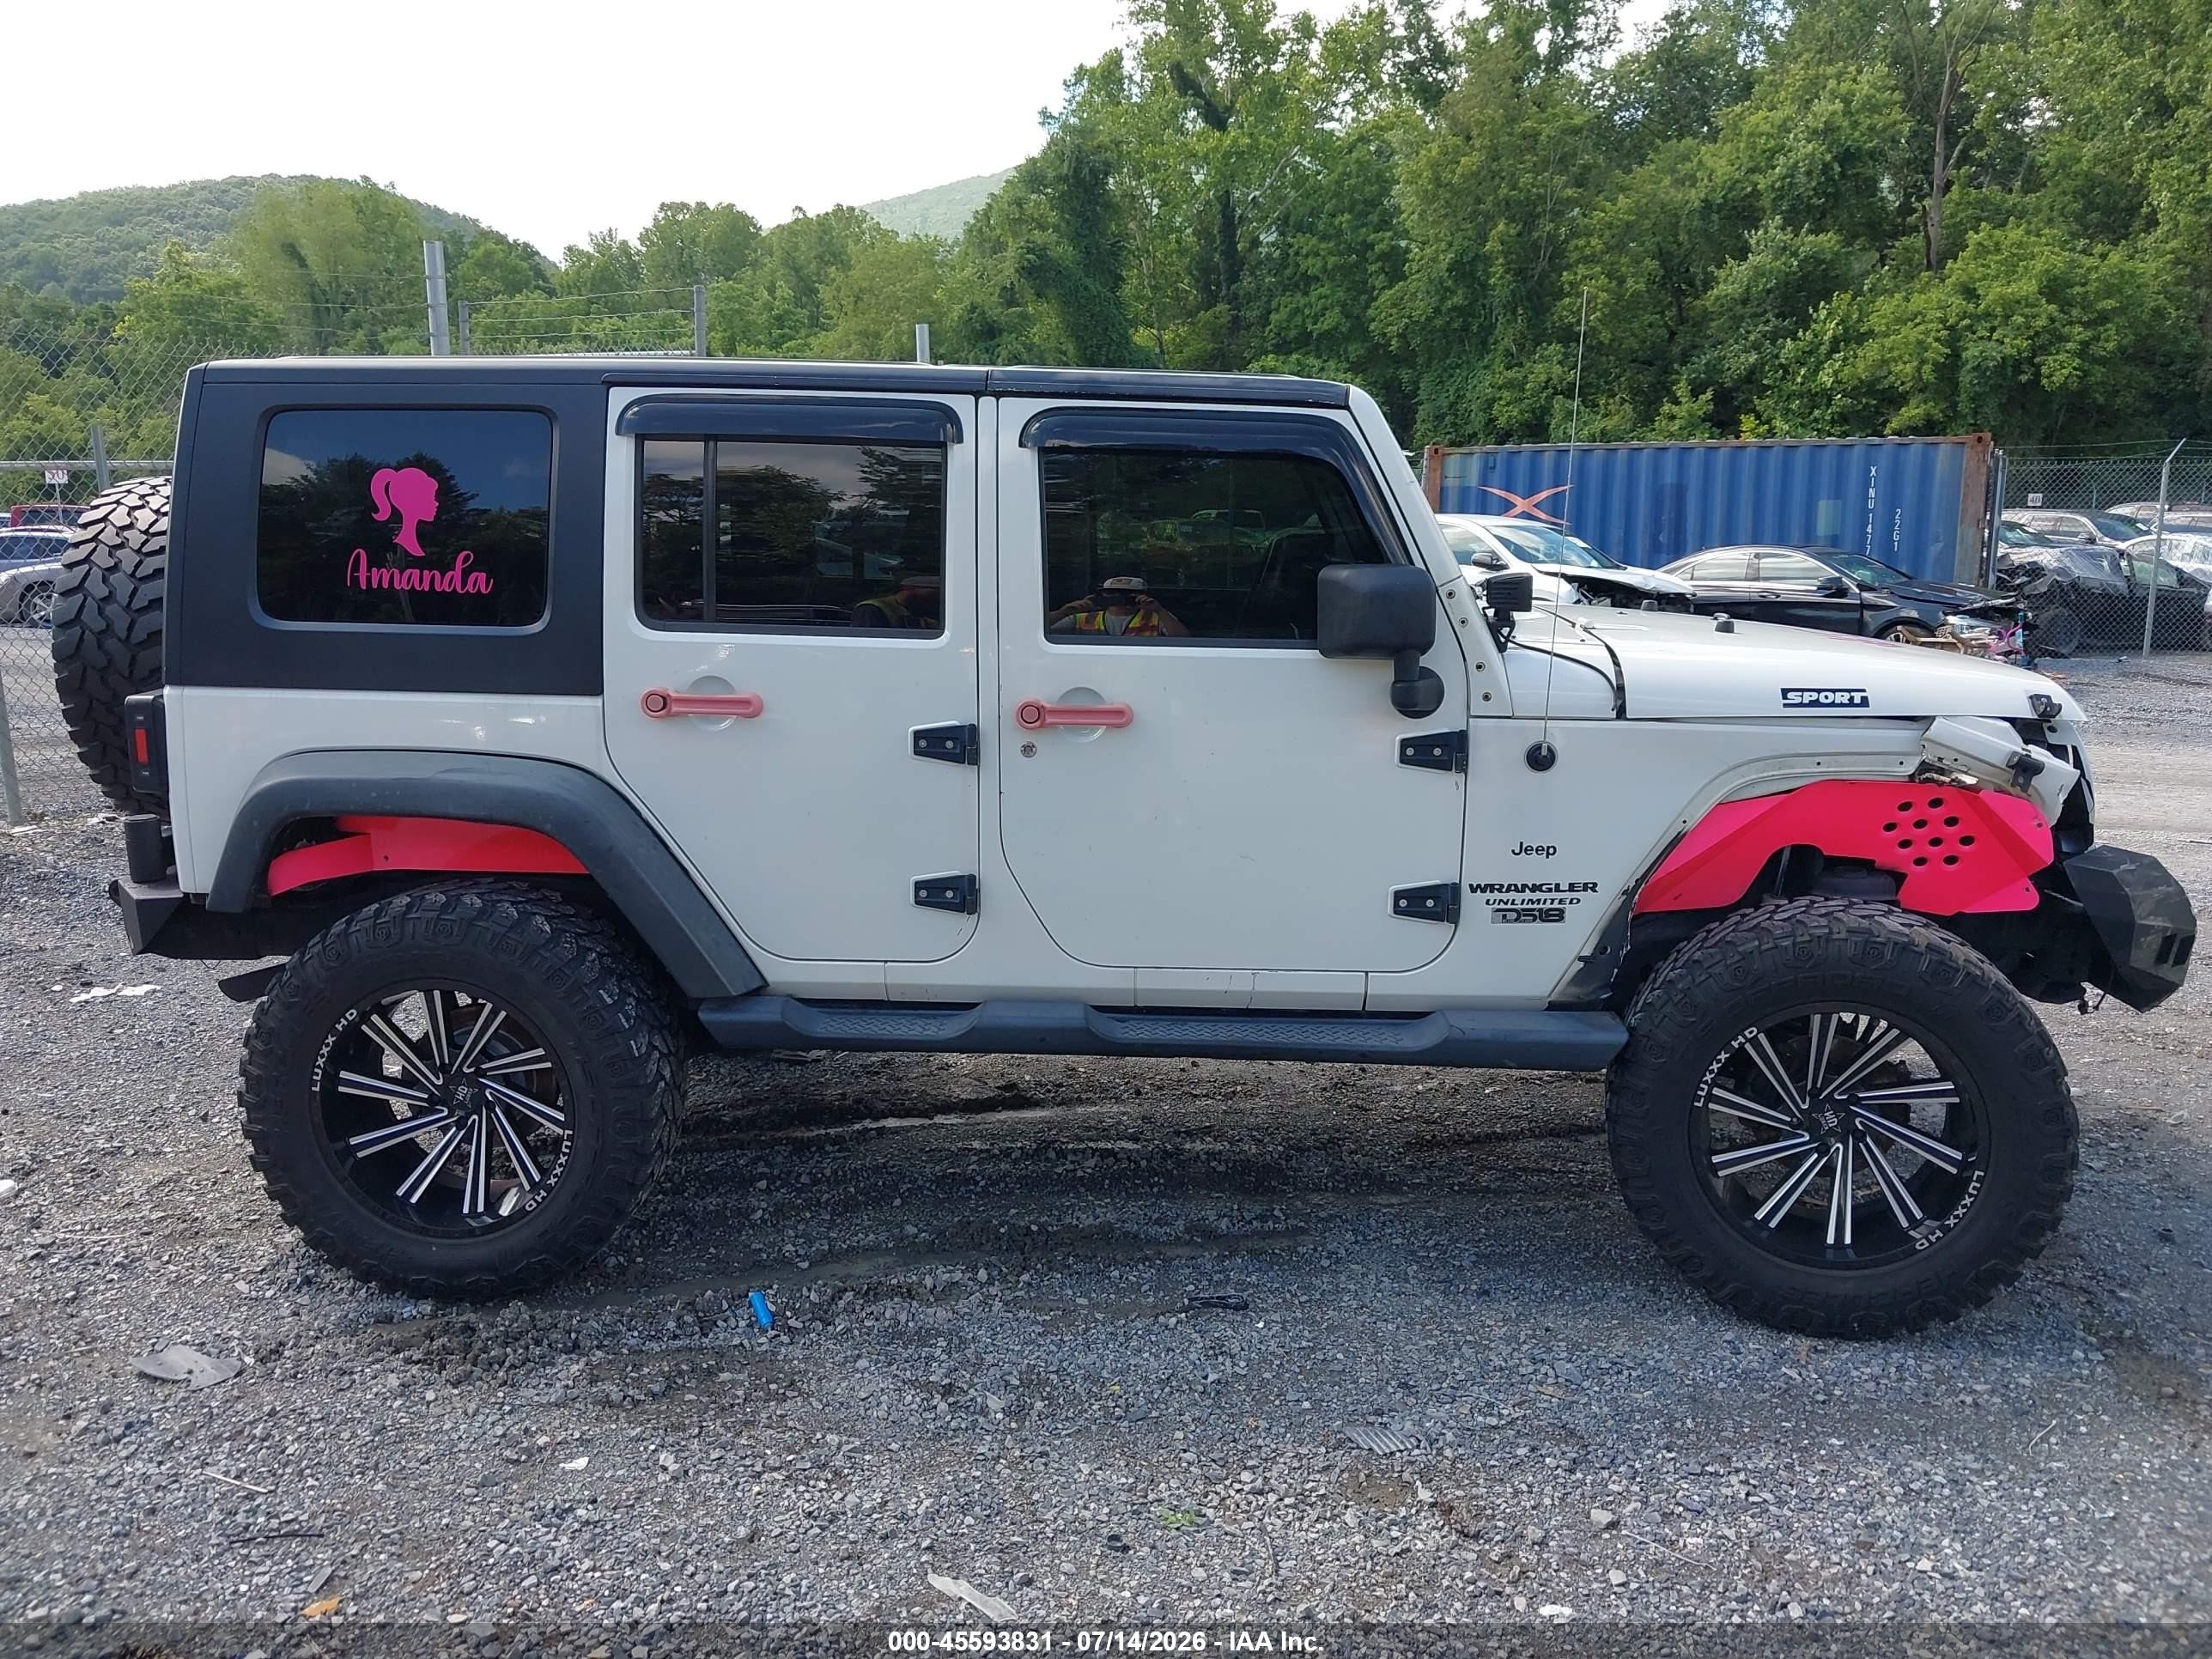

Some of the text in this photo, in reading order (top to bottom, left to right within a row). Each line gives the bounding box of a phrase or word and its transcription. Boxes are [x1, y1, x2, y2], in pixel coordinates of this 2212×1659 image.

[1868, 465, 1877, 509] XINU
[1893, 508, 1901, 552] 22G1
[347, 548, 494, 594] Amanda
[1782, 691, 1869, 704] SPORT
[1511, 841, 1558, 860] Jeep
[1468, 881, 1599, 894] WRANGLER
[1485, 897, 1582, 907] UNLIMITED
[311, 1009, 358, 1091] LUXXX HD
[1693, 1027, 1758, 1108] LUXXX HD
[525, 1129, 574, 1212] LUXXX HD
[1914, 1170, 1985, 1250] LUXXX HD
